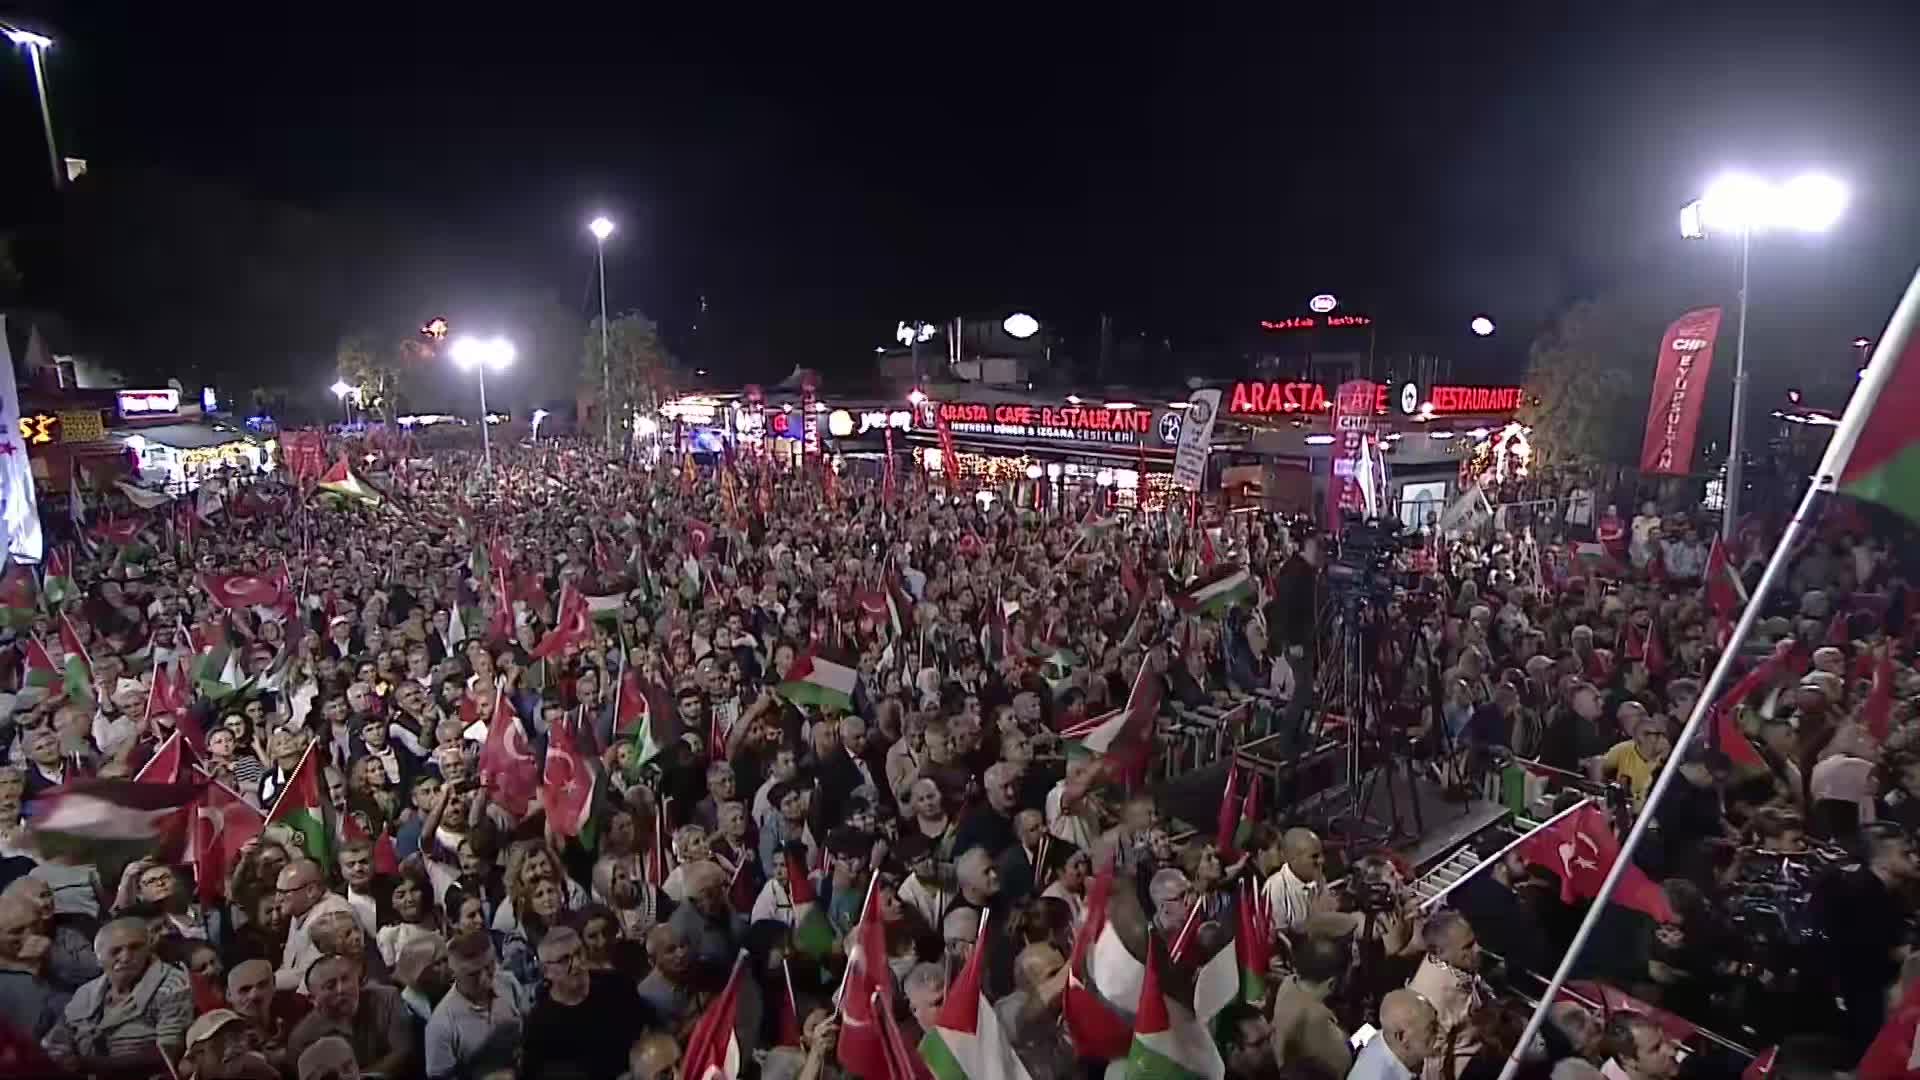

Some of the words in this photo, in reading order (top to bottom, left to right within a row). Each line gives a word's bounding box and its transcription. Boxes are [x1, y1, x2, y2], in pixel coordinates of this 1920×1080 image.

[1673, 338, 1708, 351] CHP
[1231, 383, 1324, 411] ARASTA
[1433, 387, 1515, 410] RESTAURANT
[940, 404, 988, 421] ARASTA
